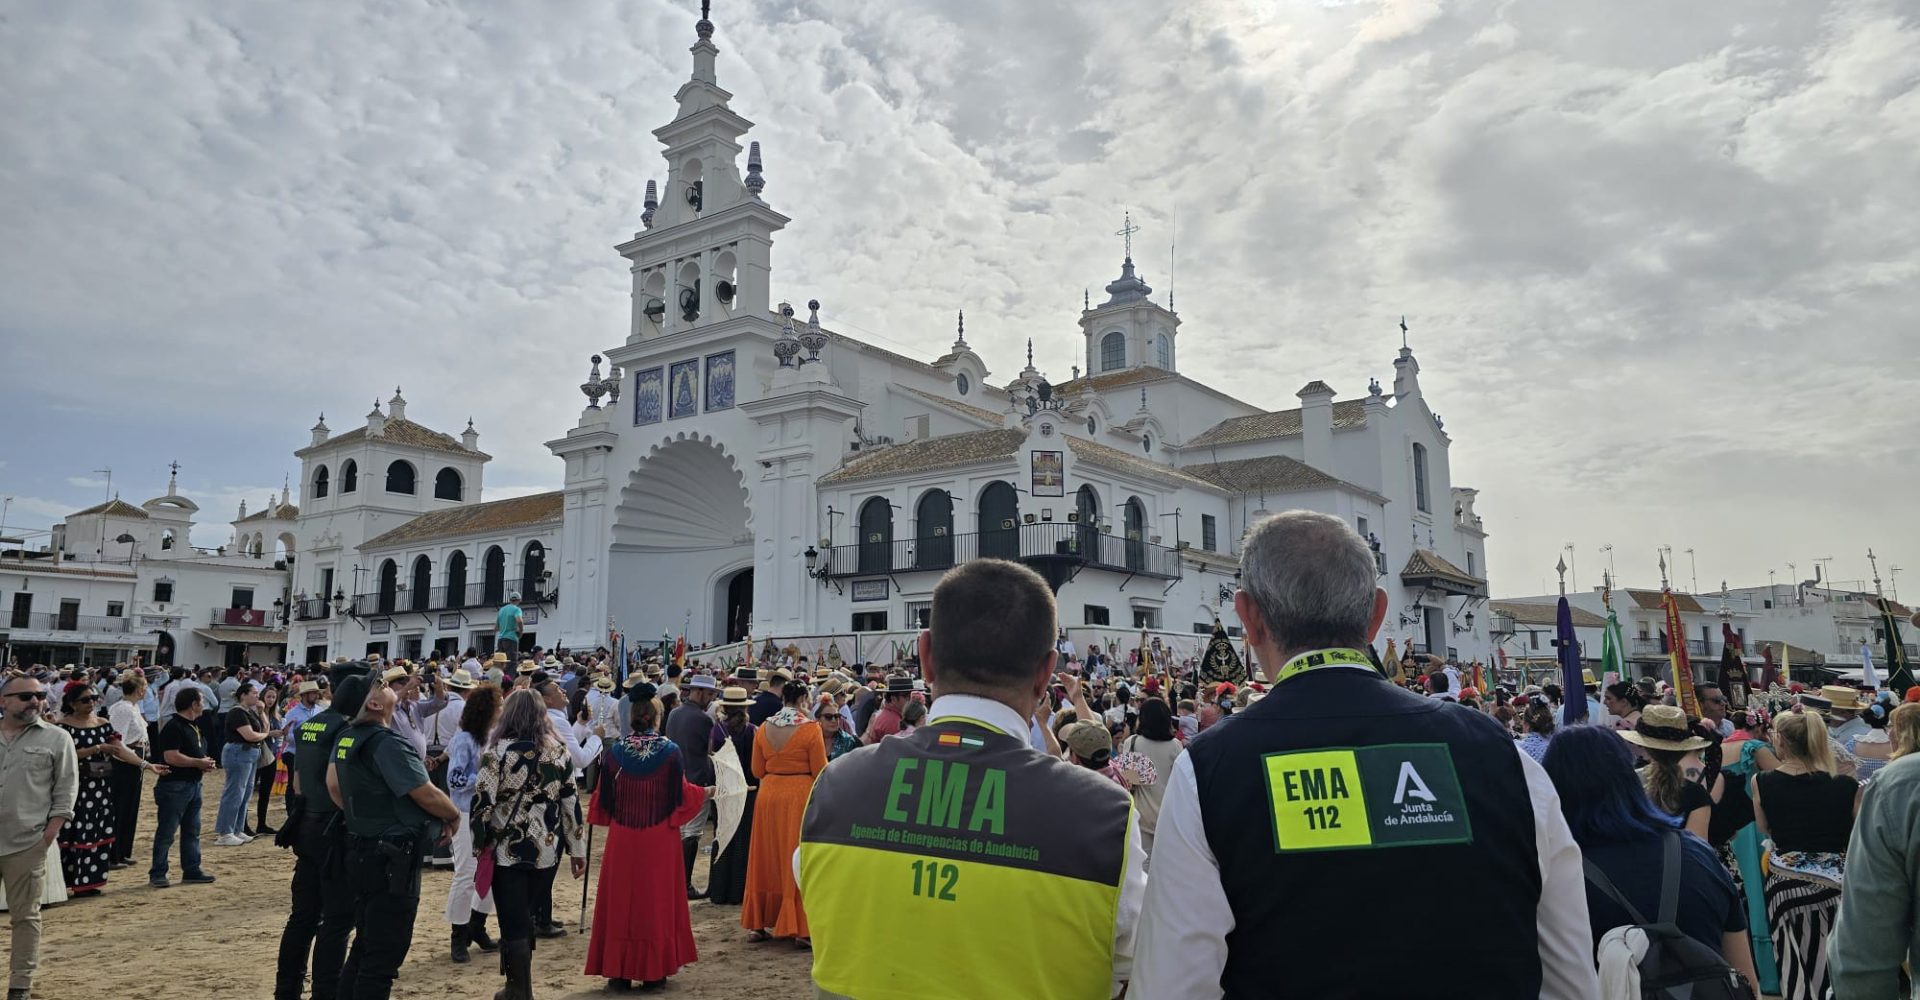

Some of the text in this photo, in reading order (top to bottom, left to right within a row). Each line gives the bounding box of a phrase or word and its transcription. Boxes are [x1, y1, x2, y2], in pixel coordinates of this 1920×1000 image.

[302, 732, 317, 741] CIVIL
[883, 757, 1007, 836] EMA
[1283, 768, 1349, 802] EMA
[1303, 806, 1341, 830] 112
[1384, 811, 1454, 827] de Andalucía
[1401, 803, 1433, 814] Junta
[850, 823, 1040, 862] Agencia de Emergencias de Andalucía
[911, 860, 959, 902] 112
